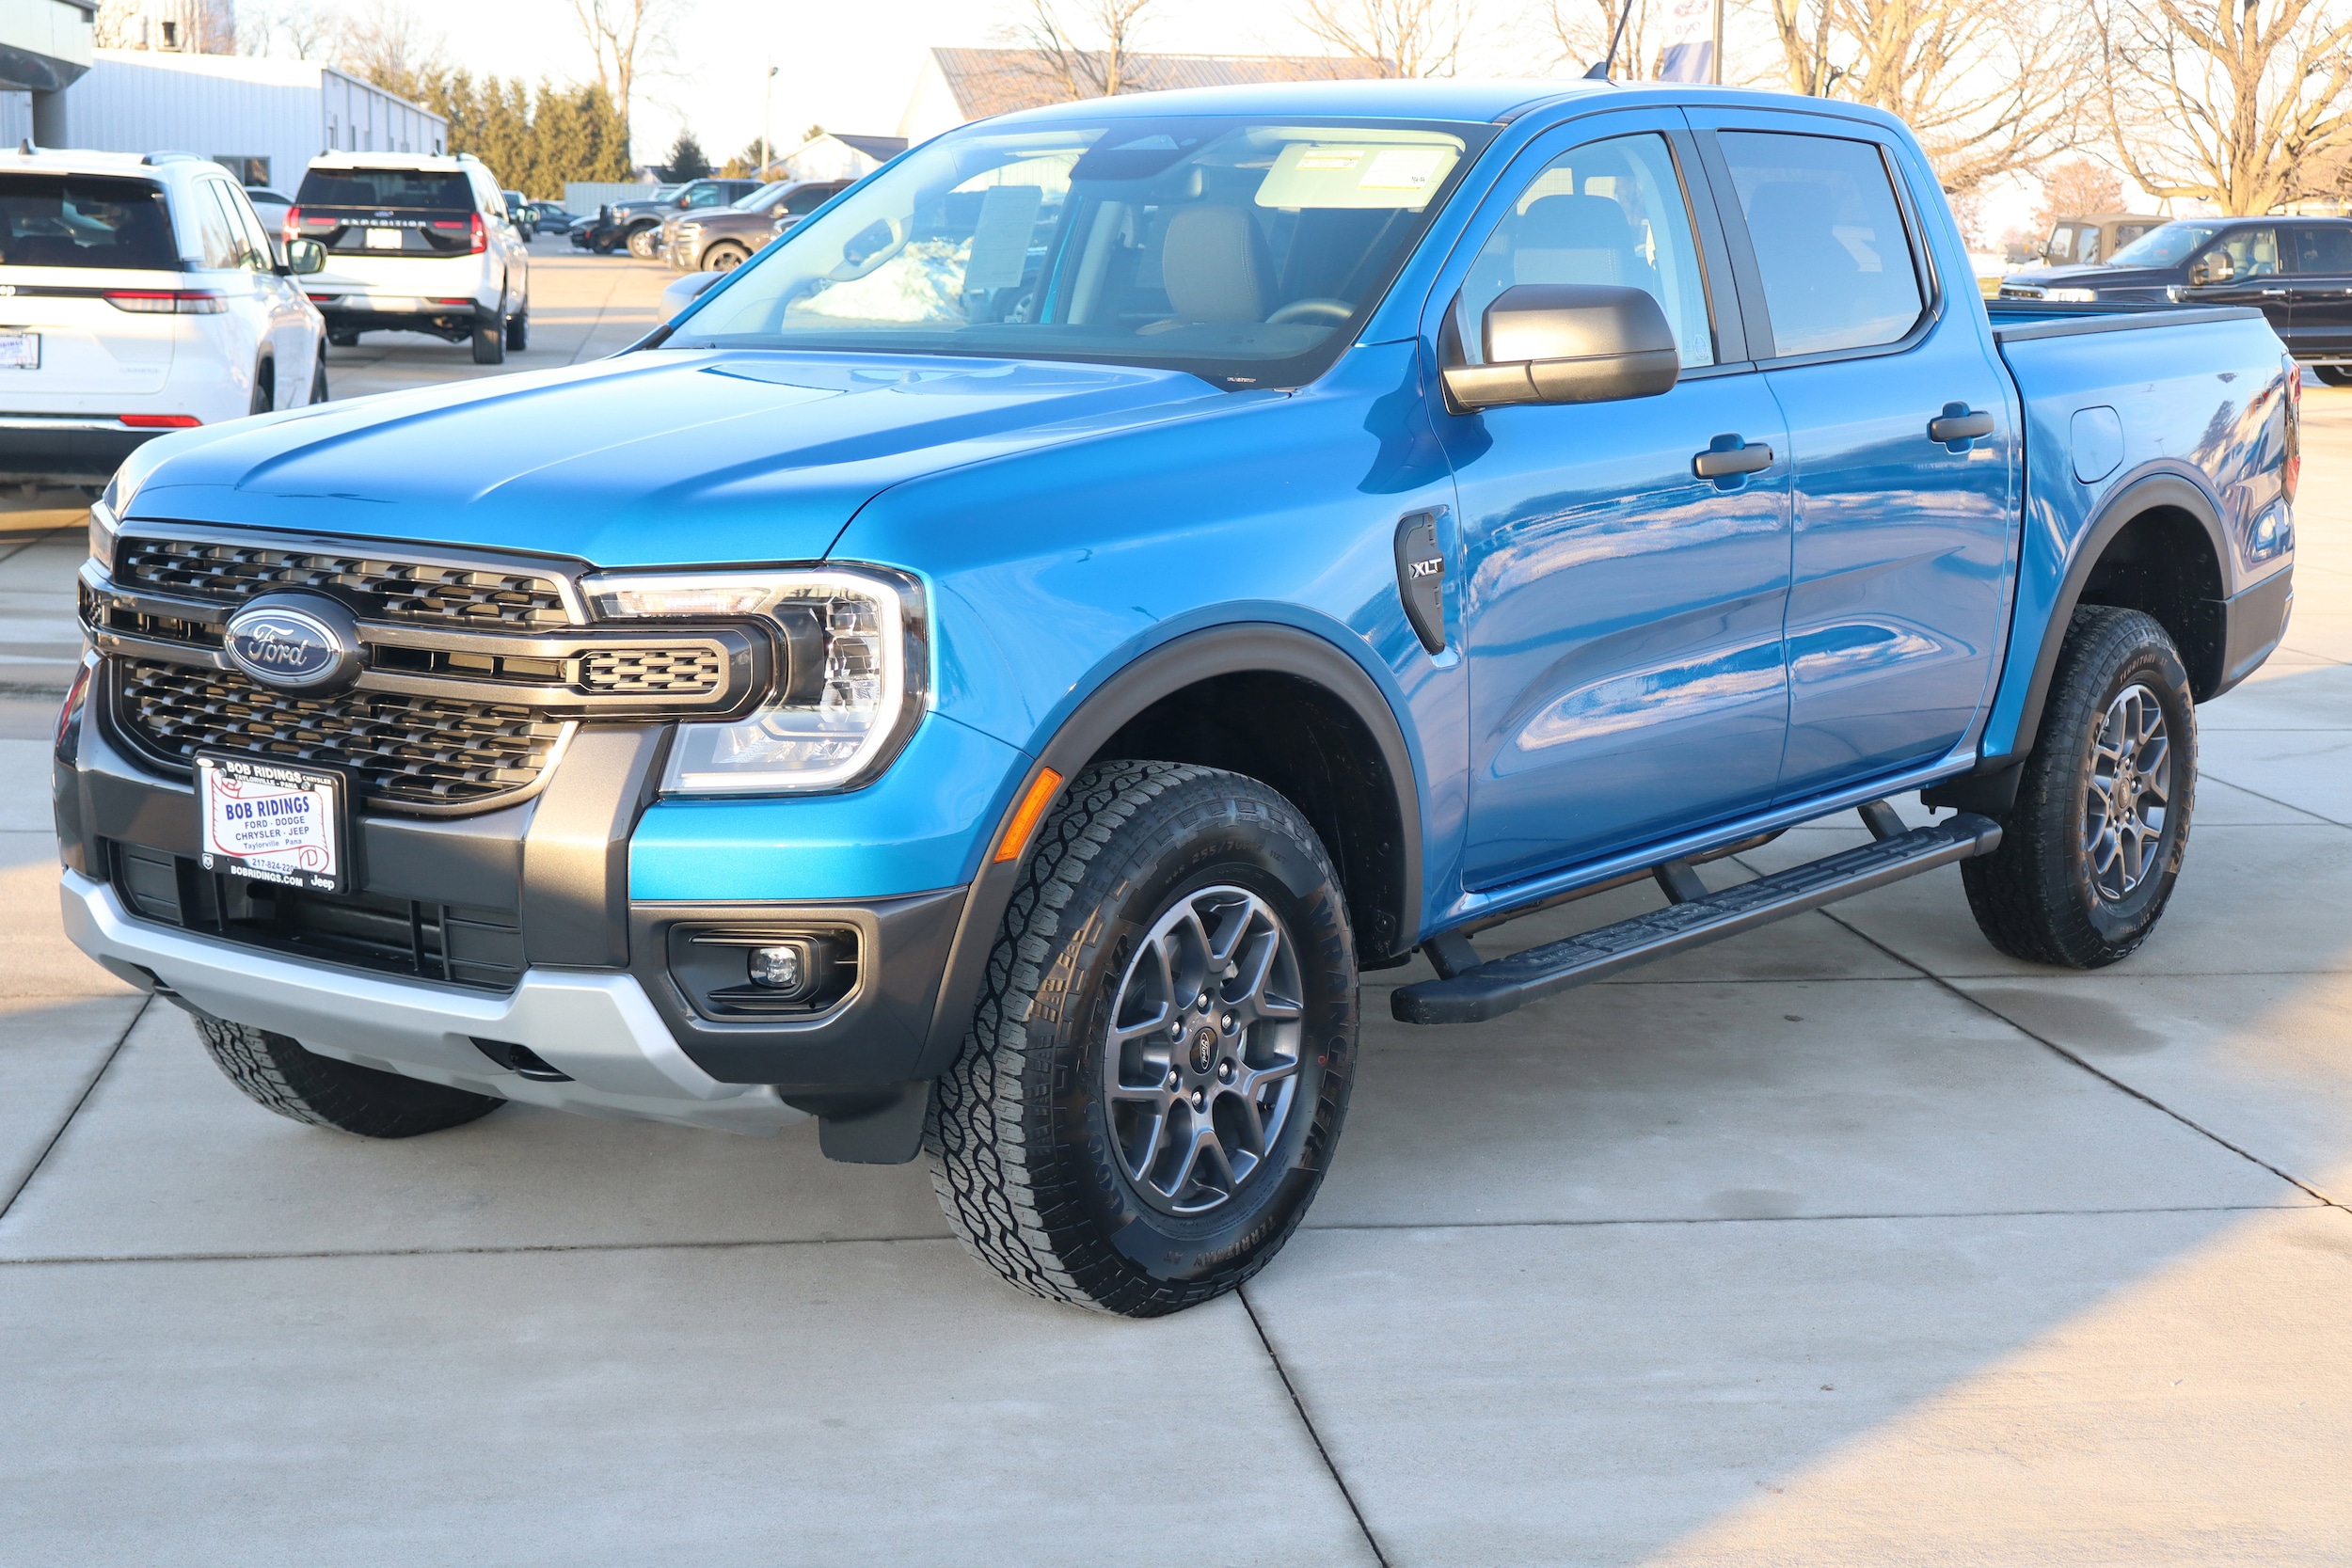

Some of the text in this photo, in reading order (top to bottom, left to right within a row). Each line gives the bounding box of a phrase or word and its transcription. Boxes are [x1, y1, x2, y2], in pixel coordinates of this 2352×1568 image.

[341, 218, 426, 228] EXPEDITION
[1411, 558, 1442, 578] XLT
[247, 624, 309, 666] Ford
[226, 761, 251, 776] BOB
[253, 765, 302, 784] RIDINGS
[302, 775, 332, 785] CHRYSLER
[233, 774, 275, 785] TAYLORVILLE
[280, 781, 298, 789] PANA
[226, 796, 310, 820] BOB RIDINGS
[245, 820, 268, 829] FORD
[276, 816, 305, 826] DODGE
[235, 829, 281, 841] CHRYSLER
[288, 827, 310, 836] JEEP
[244, 841, 279, 850] Taylorville
[230, 865, 303, 887] BOBRIDINGS.COM
[310, 875, 335, 891] Jeep
[1193, 1216, 1276, 1268] TERRITORY
